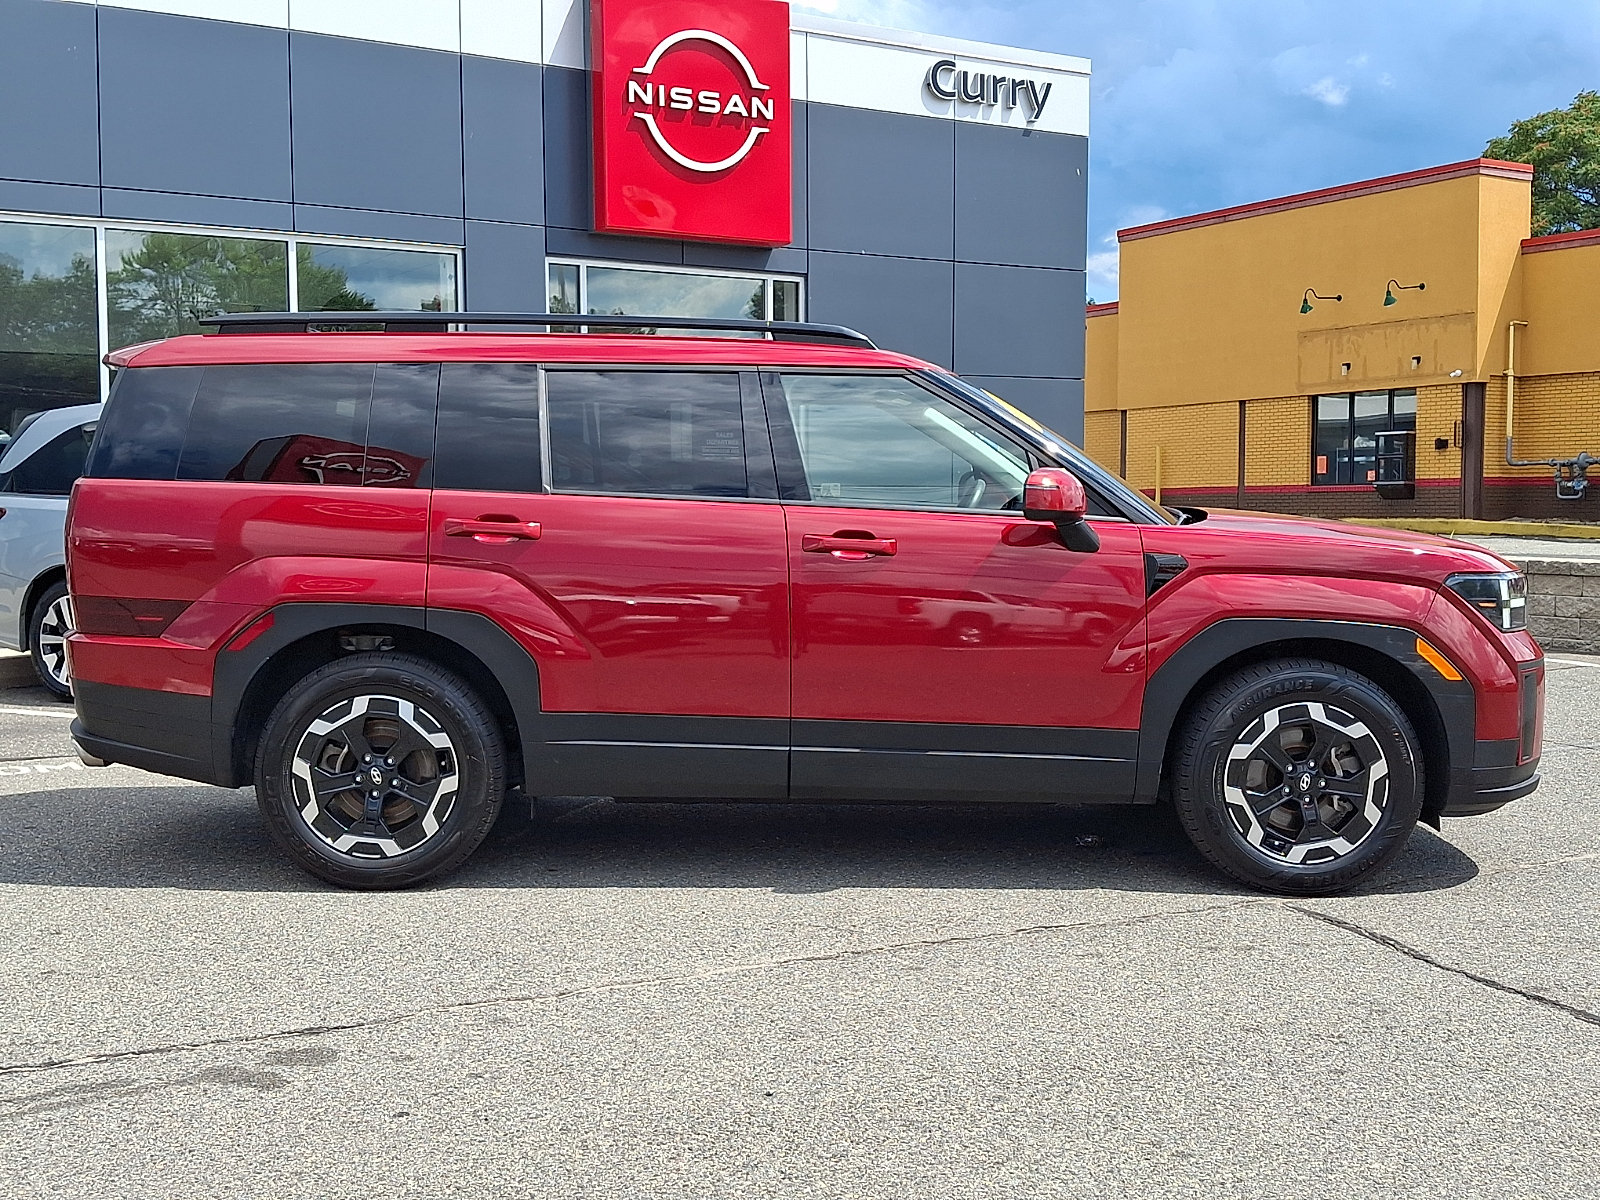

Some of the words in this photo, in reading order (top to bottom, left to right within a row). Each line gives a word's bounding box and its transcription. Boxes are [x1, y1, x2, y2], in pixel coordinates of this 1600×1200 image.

[628, 80, 774, 120] NISSAN
[928, 60, 1053, 121] Curry
[1231, 679, 1314, 720] ASSURANCE
